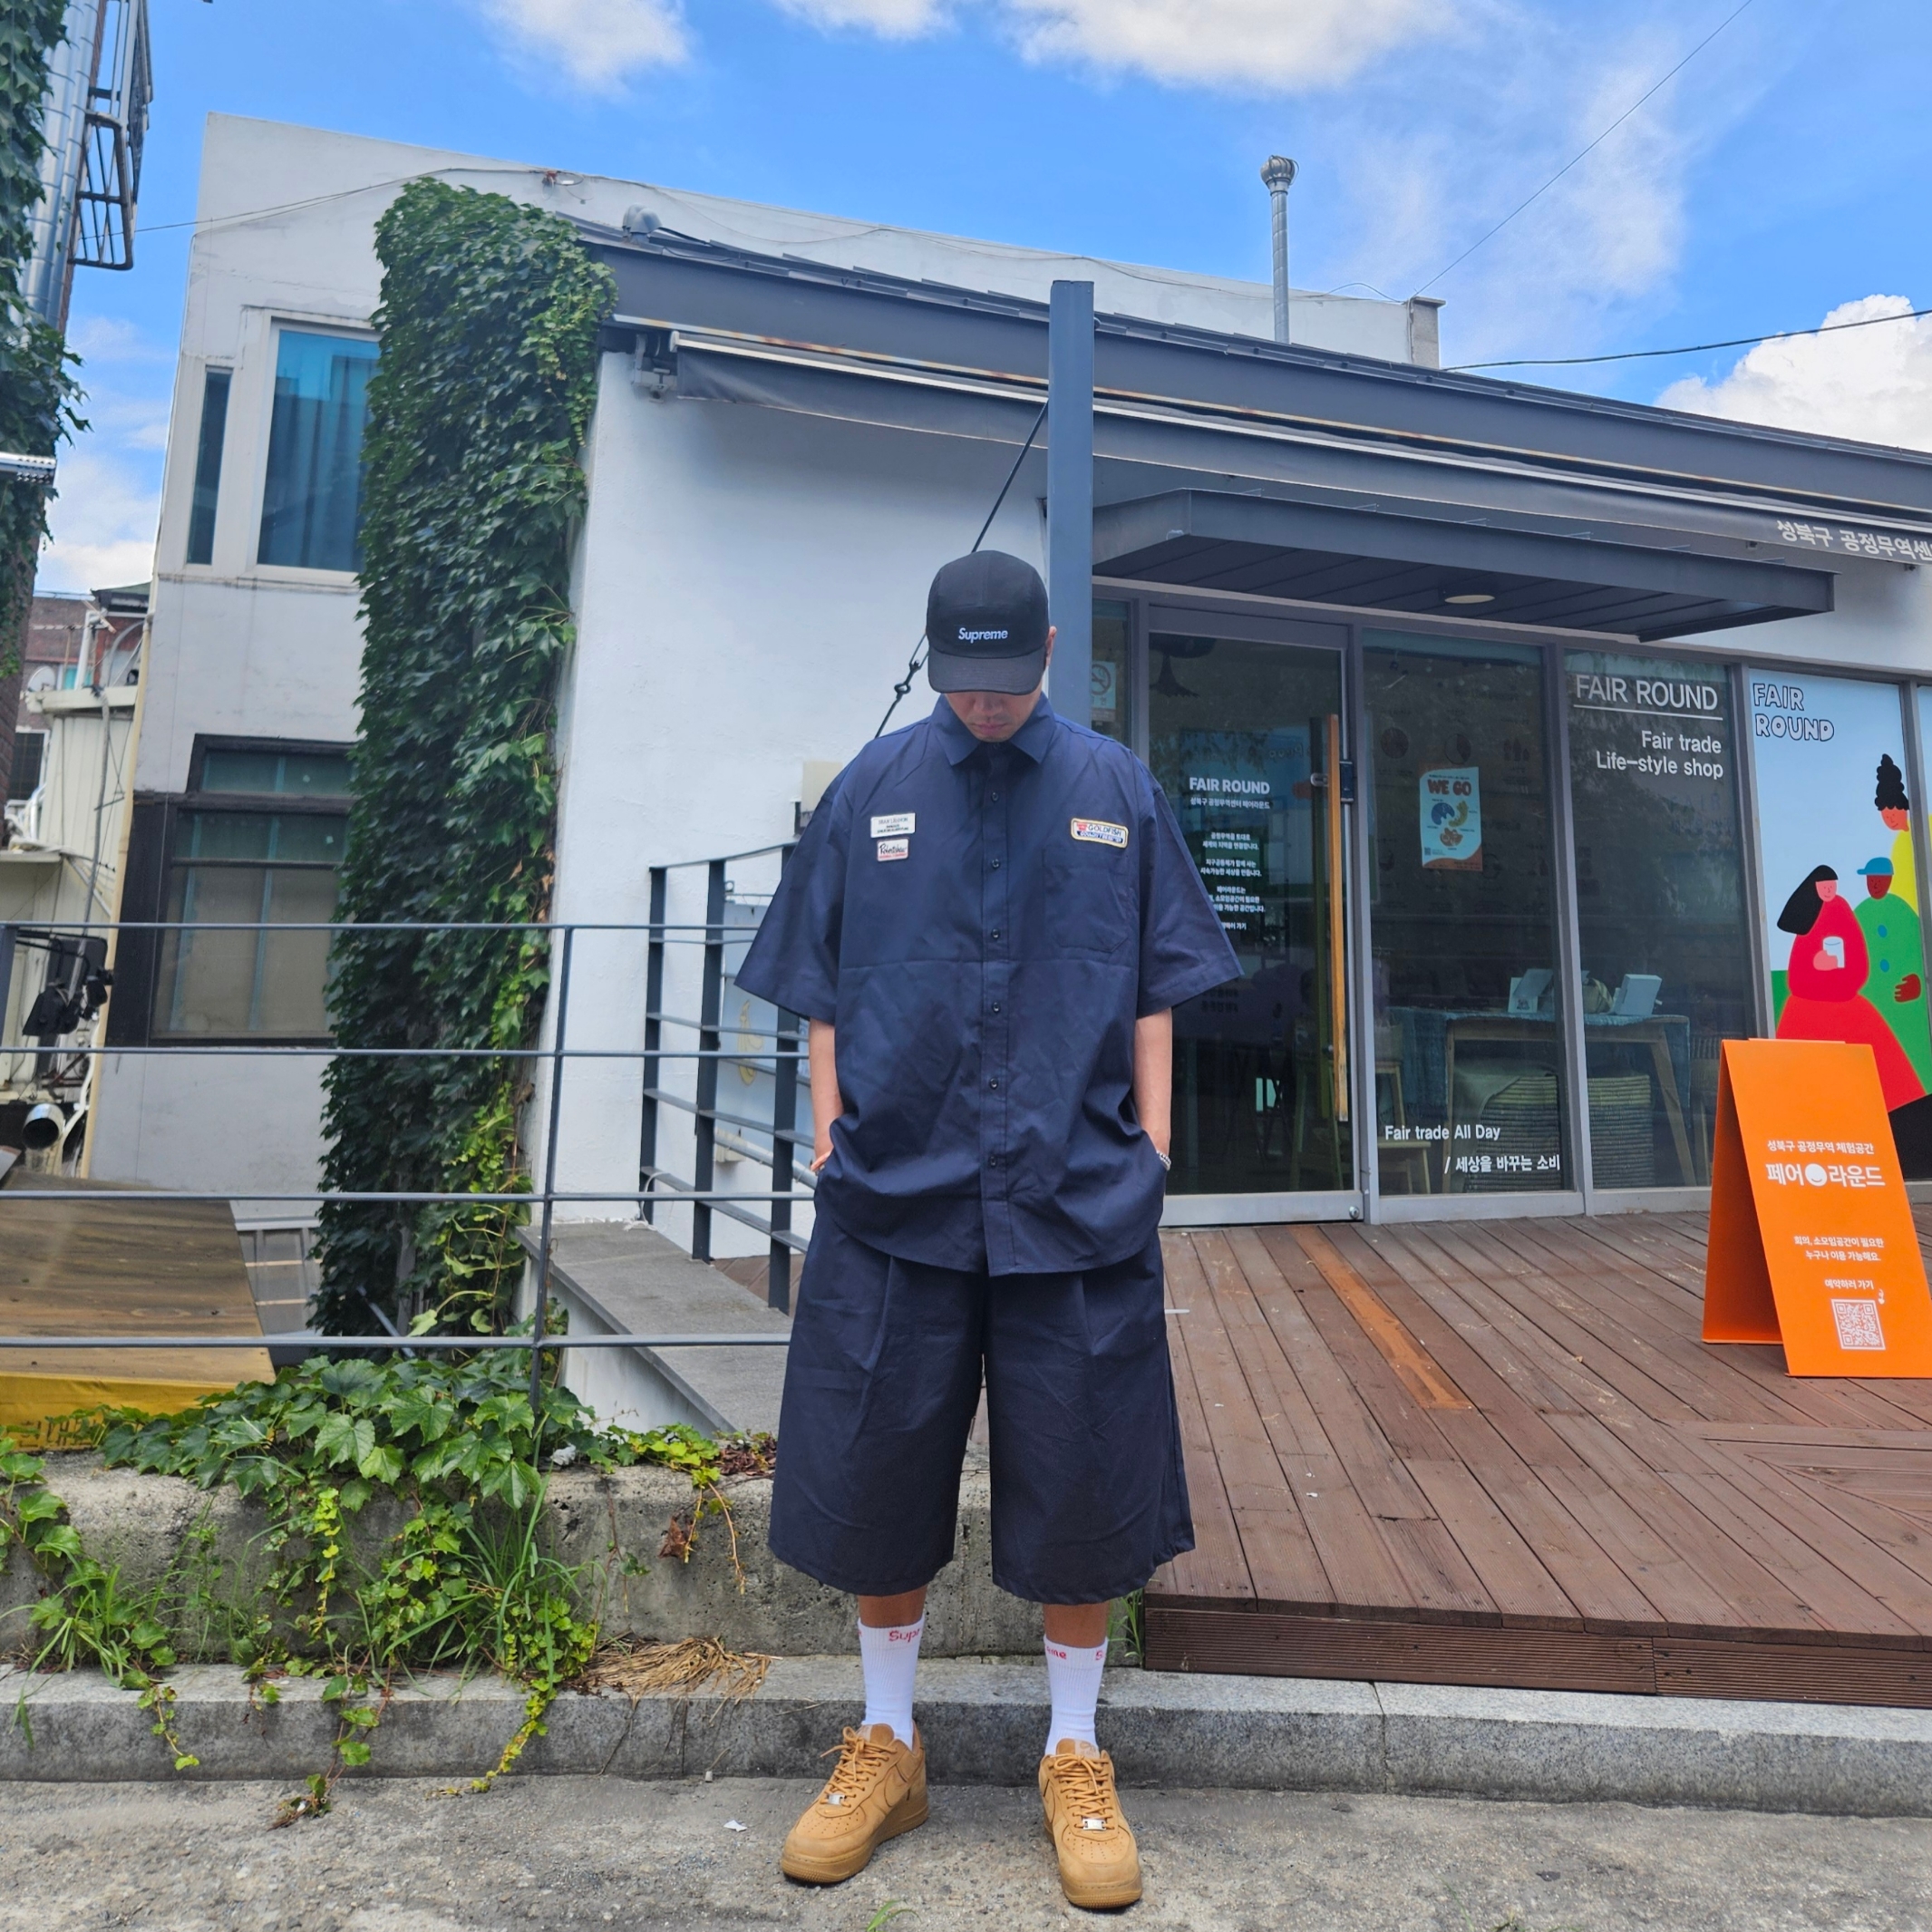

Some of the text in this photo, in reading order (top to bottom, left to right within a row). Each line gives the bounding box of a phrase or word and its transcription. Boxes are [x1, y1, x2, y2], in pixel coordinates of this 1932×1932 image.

[1777, 520, 1932, 561] 성북구 공정무역센
[958, 627, 1008, 644] Supreme
[1576, 675, 1718, 711] FAIR ROUND
[1752, 683, 1804, 711] FAIR
[1755, 714, 1835, 742] ROUND
[1642, 730, 1722, 753] Fair trade
[1684, 758, 1723, 780] shop
[1189, 777, 1270, 794] FAIR ROUND
[1427, 779, 1450, 795] WE
[1384, 1124, 1500, 1141] Fair trade All Day
[1767, 1140, 1875, 1155] 성북구 공정무역 체험공간
[1455, 1155, 1492, 1173] 세상을
[1496, 1155, 1533, 1171] 바꾸는
[1537, 1154, 1561, 1170] 소비
[1813, 1237, 1859, 1248] 소모임공간이
[1860, 1238, 1884, 1248] 필요한
[1805, 1250, 1830, 1260] 누구나
[1830, 1251, 1847, 1261] 이용
[1824, 1278, 1874, 1290] 예약하러 가기
